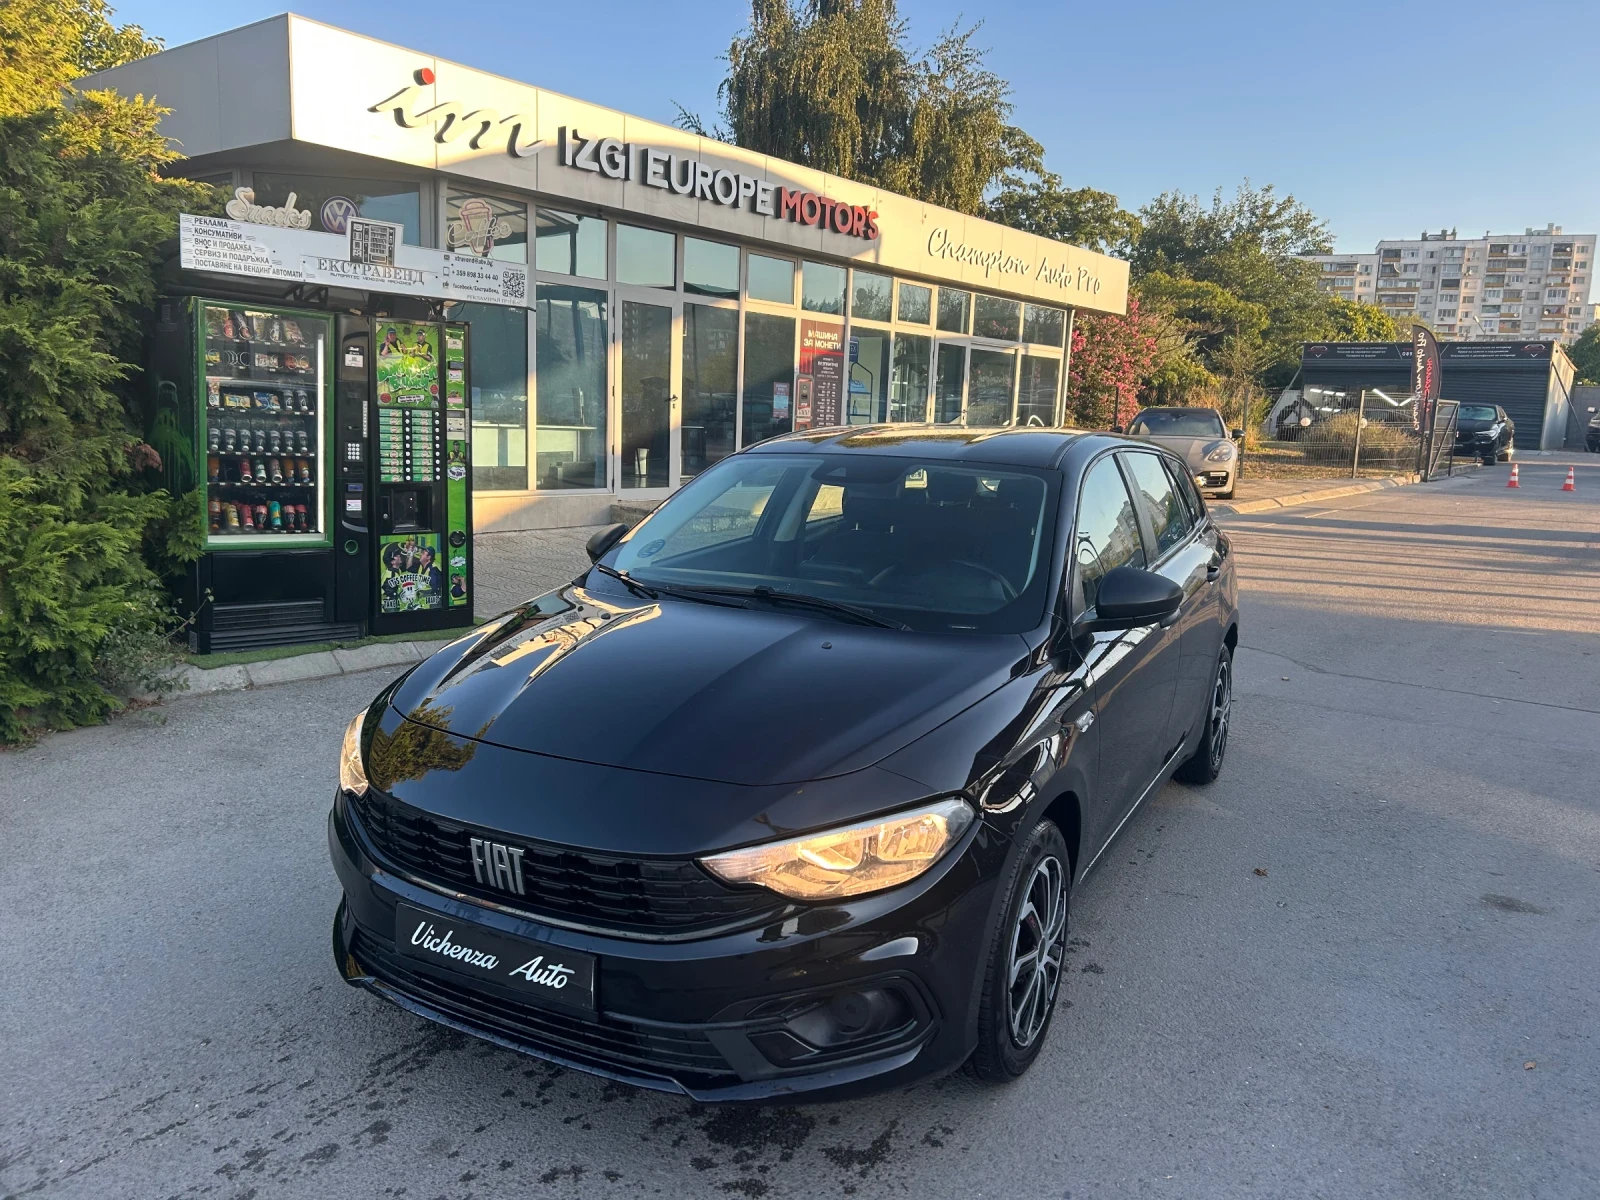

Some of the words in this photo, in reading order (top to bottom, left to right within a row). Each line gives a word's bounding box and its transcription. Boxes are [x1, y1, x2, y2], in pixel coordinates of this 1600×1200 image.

[558, 125, 635, 181] IZGI
[642, 147, 777, 216] EUROPE
[776, 186, 880, 240] MOTOR'S
[225, 187, 312, 230] Snacks
[194, 217, 228, 229] РЕКЛАМА
[446, 216, 511, 247] Coffee
[194, 228, 242, 240] КОНСУМАТИВИ
[194, 238, 212, 247] ВНОС
[212, 240, 218, 248] И
[218, 241, 252, 252] ПРОДАЖБА
[194, 248, 221, 258] СЕРВИЗ
[222, 251, 228, 259] И
[228, 252, 269, 264] ПОДДРЪЖКА
[927, 227, 1030, 278] Champion
[1036, 257, 1072, 289] Auto
[1077, 265, 1102, 295] Pro
[195, 259, 232, 270] ПОСТАВЯНЕ
[233, 263, 242, 271] НА
[243, 264, 271, 275] ВЕНДИНГ
[272, 267, 303, 279] АВТОМАТИ
[317, 258, 425, 286] ЕКСТРАВЕНД
[803, 338, 814, 347] ЗА
[815, 340, 842, 350] МОНЕТИ
[808, 330, 838, 341] МАШИНА
[400, 573, 418, 583] COFFEE
[418, 574, 431, 585] TIME
[470, 837, 526, 896] FIAT
[411, 921, 500, 970] Vichenza
[508, 956, 576, 989] Auto
